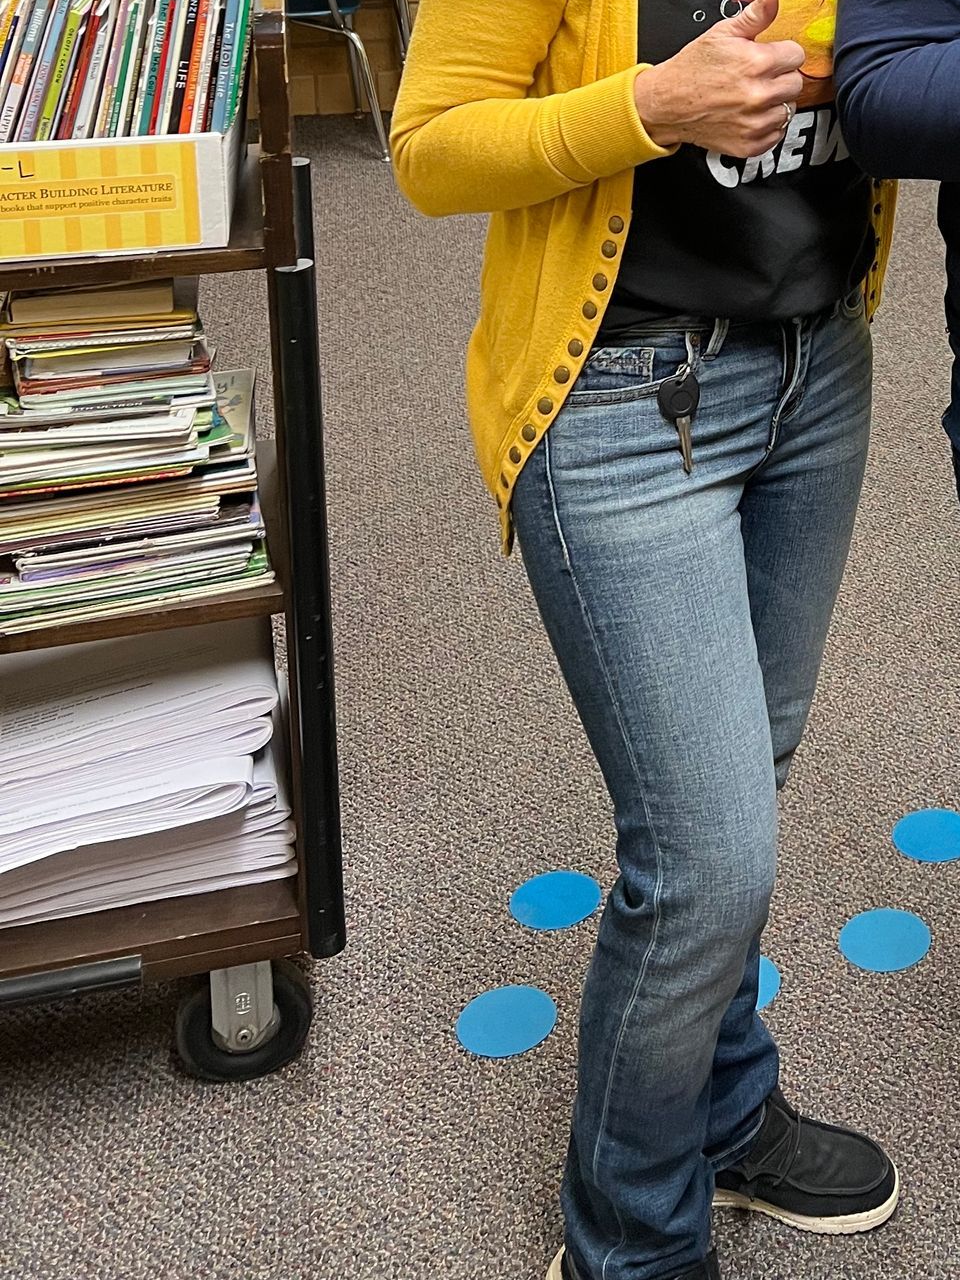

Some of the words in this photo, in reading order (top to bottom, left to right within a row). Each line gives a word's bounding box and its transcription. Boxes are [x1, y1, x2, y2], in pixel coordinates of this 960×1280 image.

[160, 1, 169, 17] The
[26, 7, 45, 43] Willems
[224, 22, 234, 38] The
[150, 55, 160, 72] Who
[175, 60, 189, 89] LIFE
[217, 70, 228, 98] Inside
[0, 105, 14, 132] HAPPY
[40, 187, 98, 198] BUILDING
[101, 182, 173, 195] LITERATURE
[1, 204, 24, 213] books
[27, 203, 43, 211] that
[45, 201, 77, 211] support
[79, 199, 110, 208] positive
[112, 197, 149, 206] character
[151, 195, 172, 203] traits
